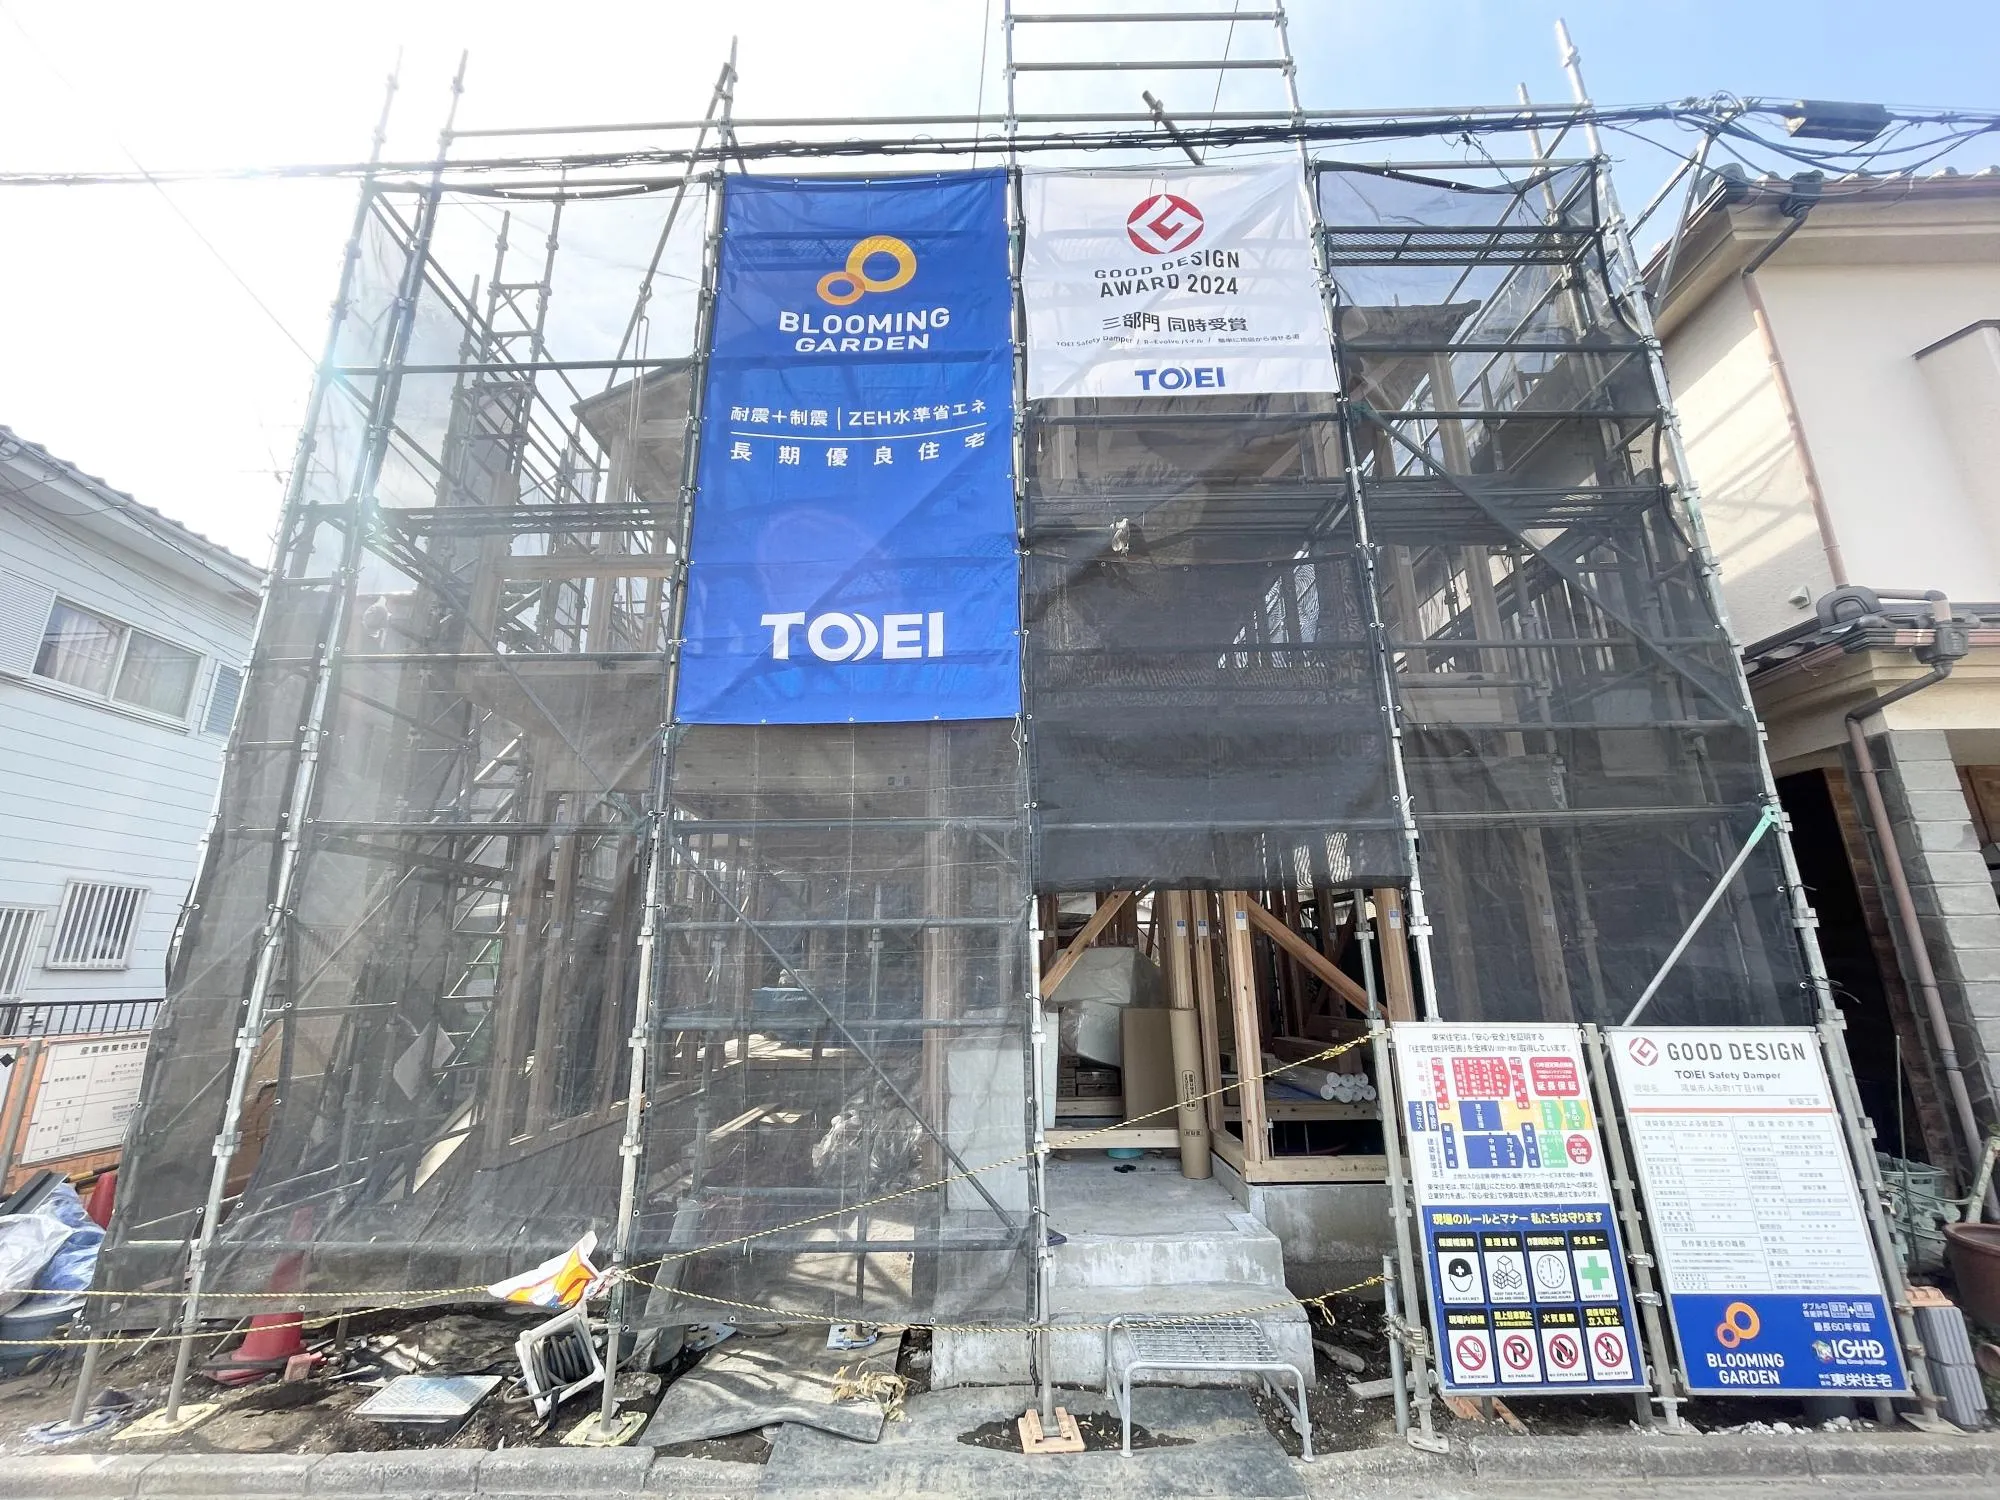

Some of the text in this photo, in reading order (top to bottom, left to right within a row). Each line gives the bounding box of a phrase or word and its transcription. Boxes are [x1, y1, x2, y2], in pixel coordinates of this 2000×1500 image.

[1094, 249, 1240, 279] GOOD DESIGN
[1100, 273, 1239, 298] AWARD 2024
[779, 307, 950, 334] BLOOMING
[1102, 311, 1249, 333] 三部門 同時受賞
[795, 334, 930, 353] GARDEN
[1134, 367, 1226, 391] TOEI
[730, 400, 987, 426] 耐震+制震 ZEH水準省エネ
[730, 432, 986, 467] 長期優良住宅
[760, 611, 944, 662] TOEI
[1667, 1042, 1807, 1061] GOOD DESIGN
[1675, 1070, 1781, 1081] TOEI Safety Damper
[1432, 1212, 1603, 1225] 現場のルールとマナー 私たちは守ります
[1573, 1236, 1604, 1245] 安全第一
[1588, 1316, 1620, 1326] 立入禁止
[1831, 1339, 1885, 1358] IGHD
[1706, 1353, 1785, 1368] BLOOMING
[1718, 1370, 1781, 1385] GARDEN
[1830, 1373, 1893, 1388] 東栄住宅
